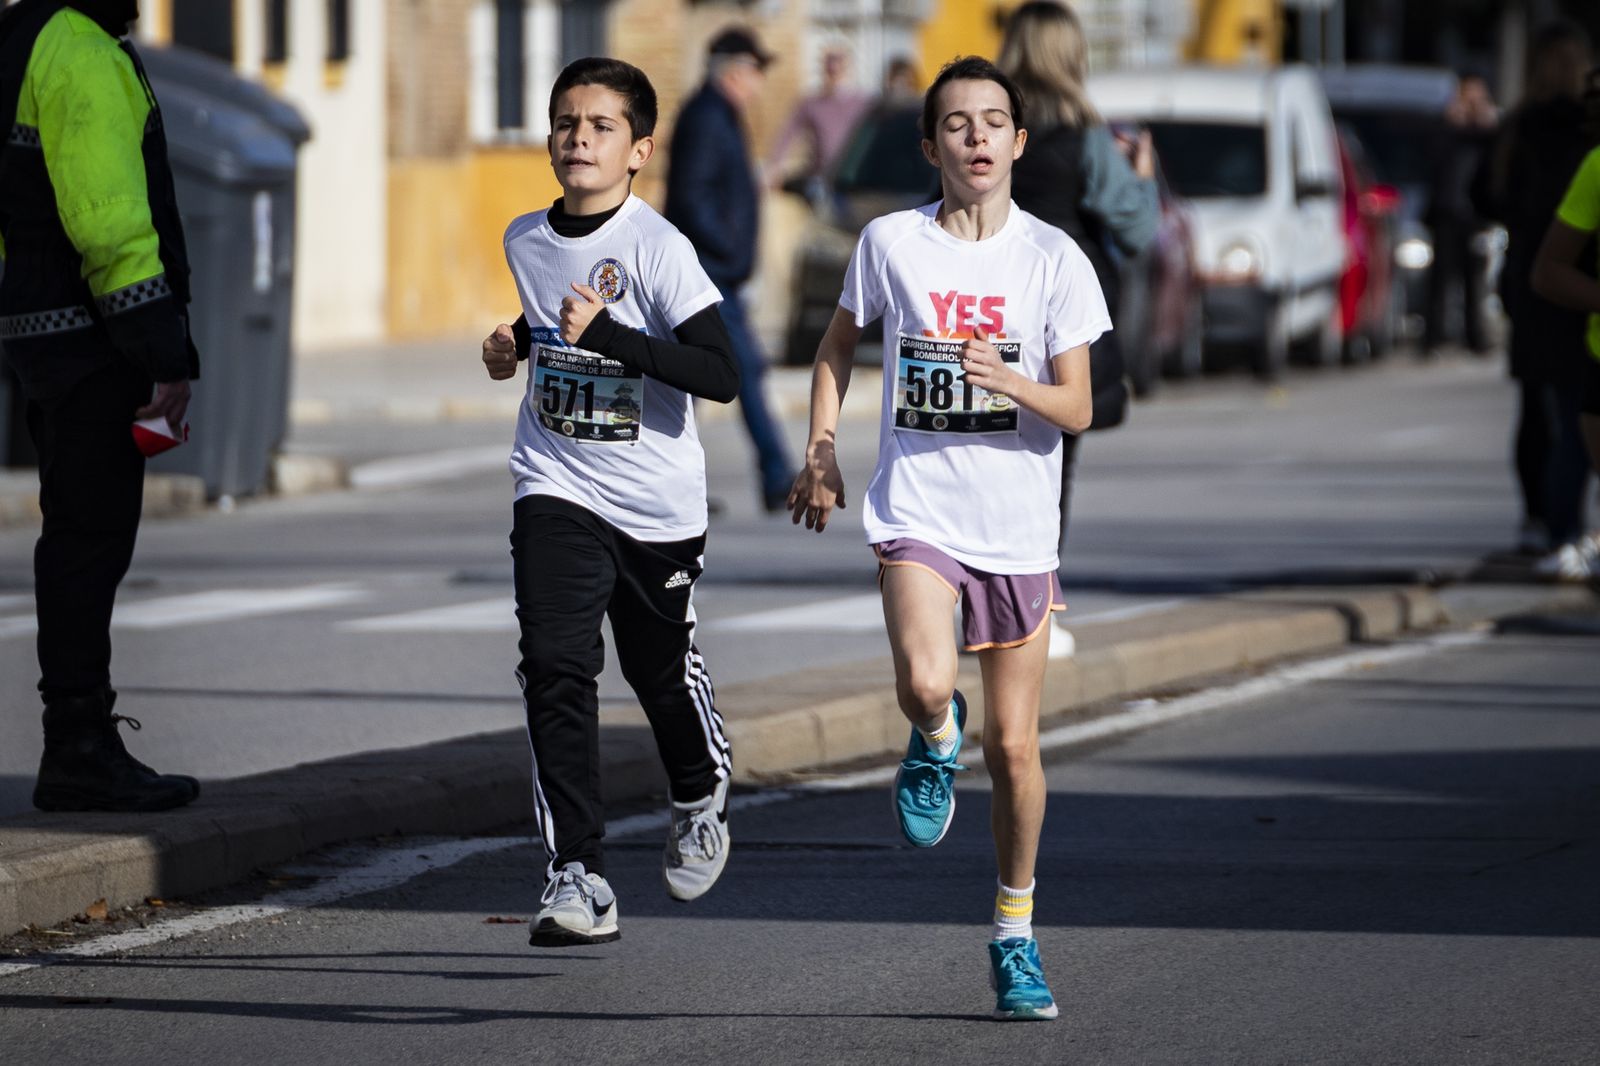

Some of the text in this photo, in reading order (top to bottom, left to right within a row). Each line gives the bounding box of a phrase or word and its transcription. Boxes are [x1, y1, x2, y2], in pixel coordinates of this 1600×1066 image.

[929, 290, 1005, 333] YES
[567, 354, 599, 366] INFANTIL
[901, 338, 936, 351] CARRERA
[937, 344, 963, 353] INFAN
[547, 360, 587, 373] BOMBEROS
[600, 368, 624, 377] JEREZ
[542, 373, 595, 420] 571
[906, 364, 974, 411] 581
